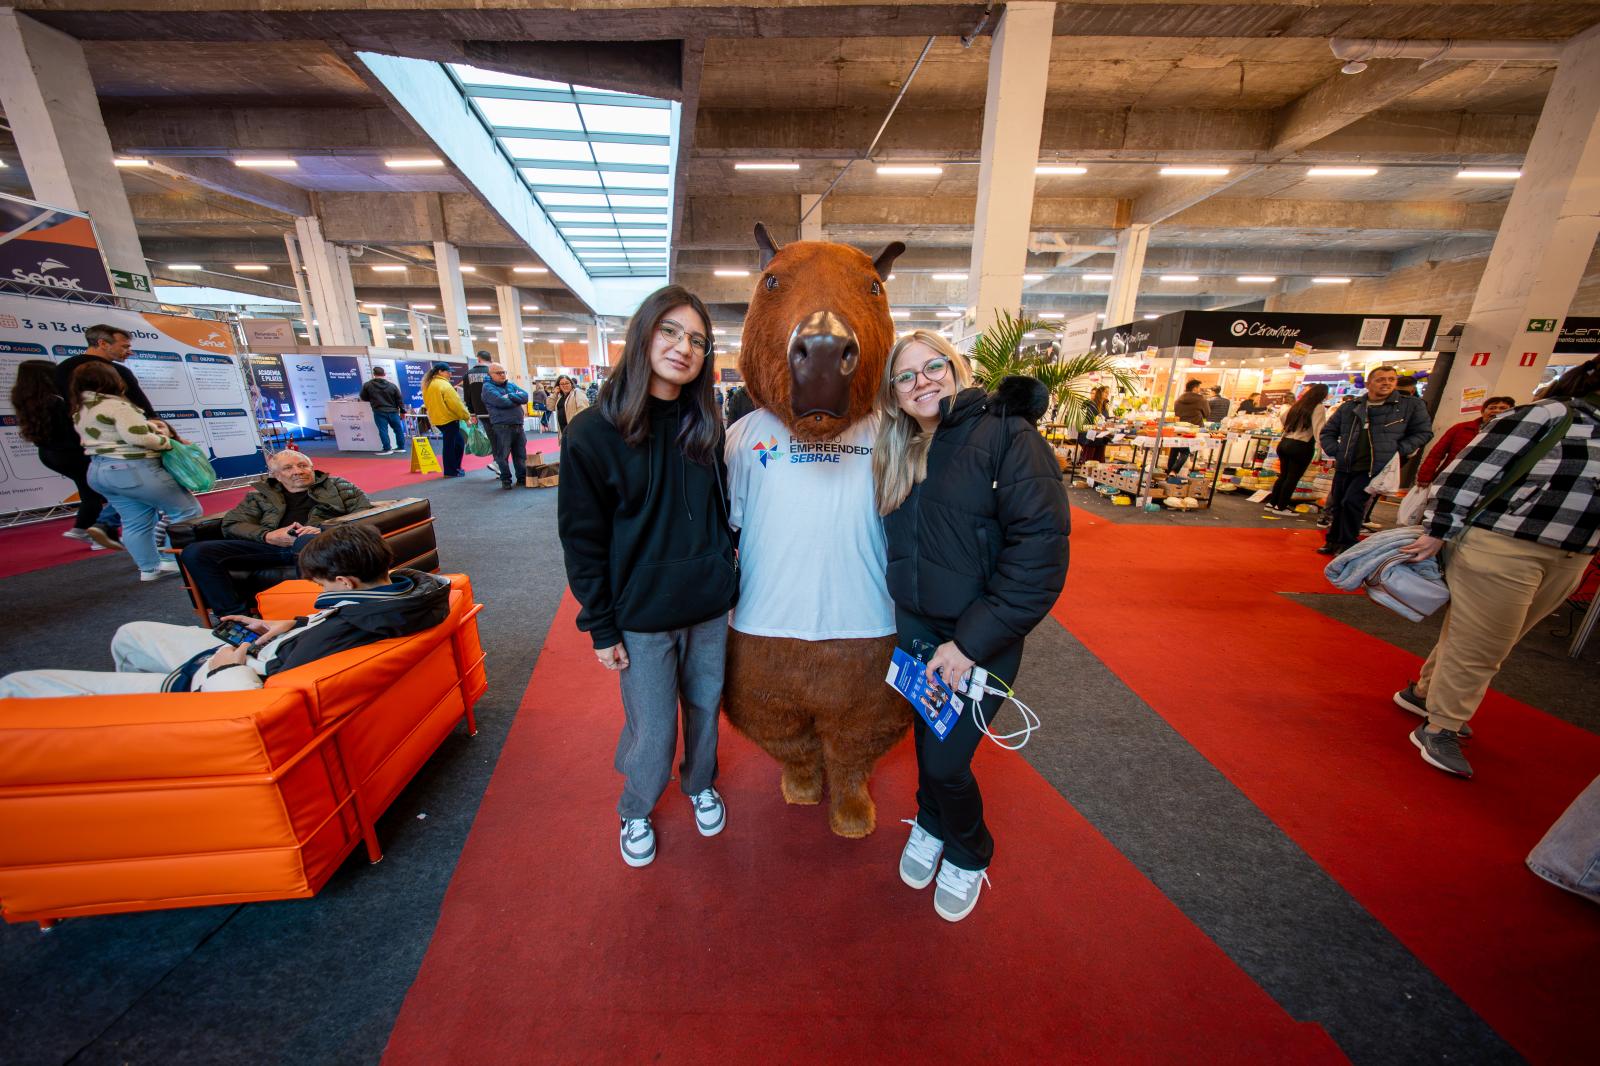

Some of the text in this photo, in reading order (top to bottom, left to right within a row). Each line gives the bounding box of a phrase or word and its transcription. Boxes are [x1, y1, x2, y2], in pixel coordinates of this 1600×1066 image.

[21, 318, 33, 329] 3
[51, 321, 68, 331] 13
[295, 364, 315, 372] Sesc
[790, 453, 841, 464] SEBRAE
